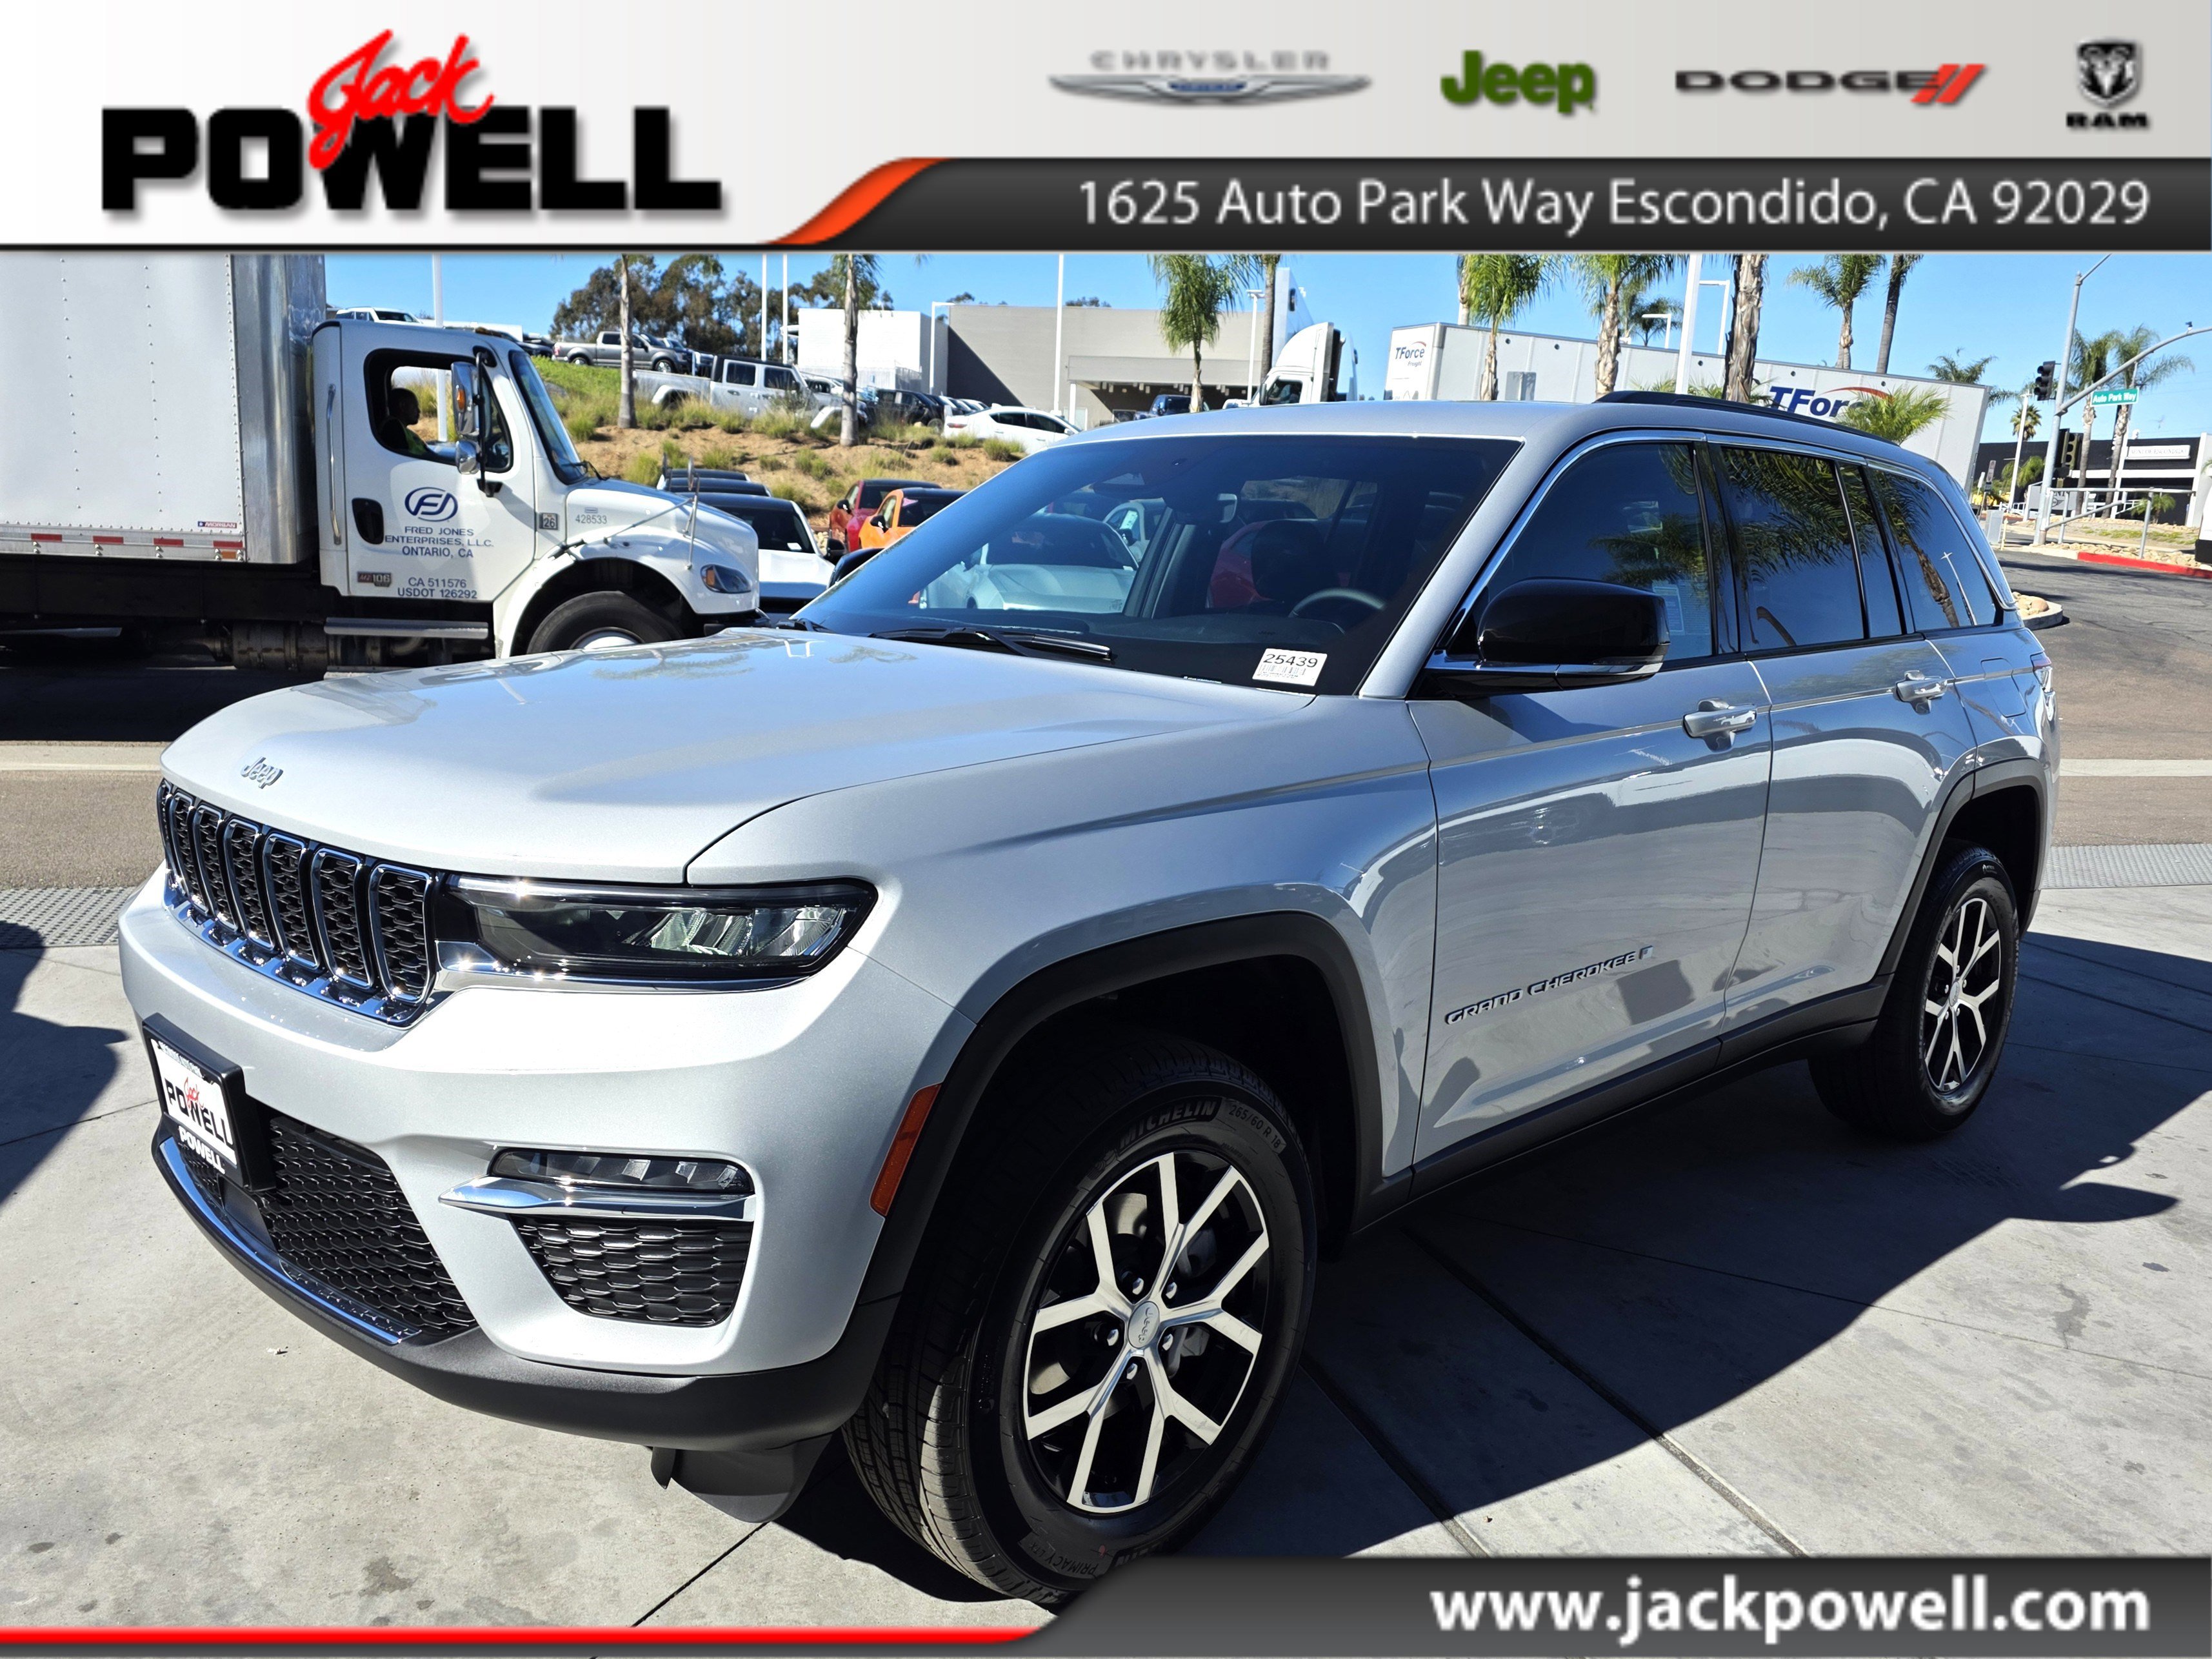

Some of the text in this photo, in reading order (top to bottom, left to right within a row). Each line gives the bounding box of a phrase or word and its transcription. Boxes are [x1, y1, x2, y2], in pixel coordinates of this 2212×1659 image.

[1395, 347, 1424, 359] TForce
[2093, 392, 2136, 403] Auto Park Way
[544, 518, 555, 528] 26
[575, 514, 607, 524] 428533
[404, 526, 474, 536] FRED JONES
[385, 535, 494, 547] ENTERPRISES, L.L.C.
[402, 546, 473, 558] ONTARIO, CA
[373, 574, 390, 582] 106
[408, 578, 466, 588] CA 511576
[397, 588, 477, 599] USDOT 126292
[1263, 654, 1318, 667] 25439
[241, 756, 284, 789] Jeep
[1445, 951, 1637, 1025] GRAND CHEROKEE
[164, 1078, 234, 1146] POWELL
[1119, 1100, 1217, 1149] MICHELIN
[1228, 1103, 1280, 1149] 265/60 R 18
[178, 1125, 225, 1174] POWELL
[1137, 1307, 1154, 1343] Jeep
[1044, 1553, 1099, 1576] PRIMACY
